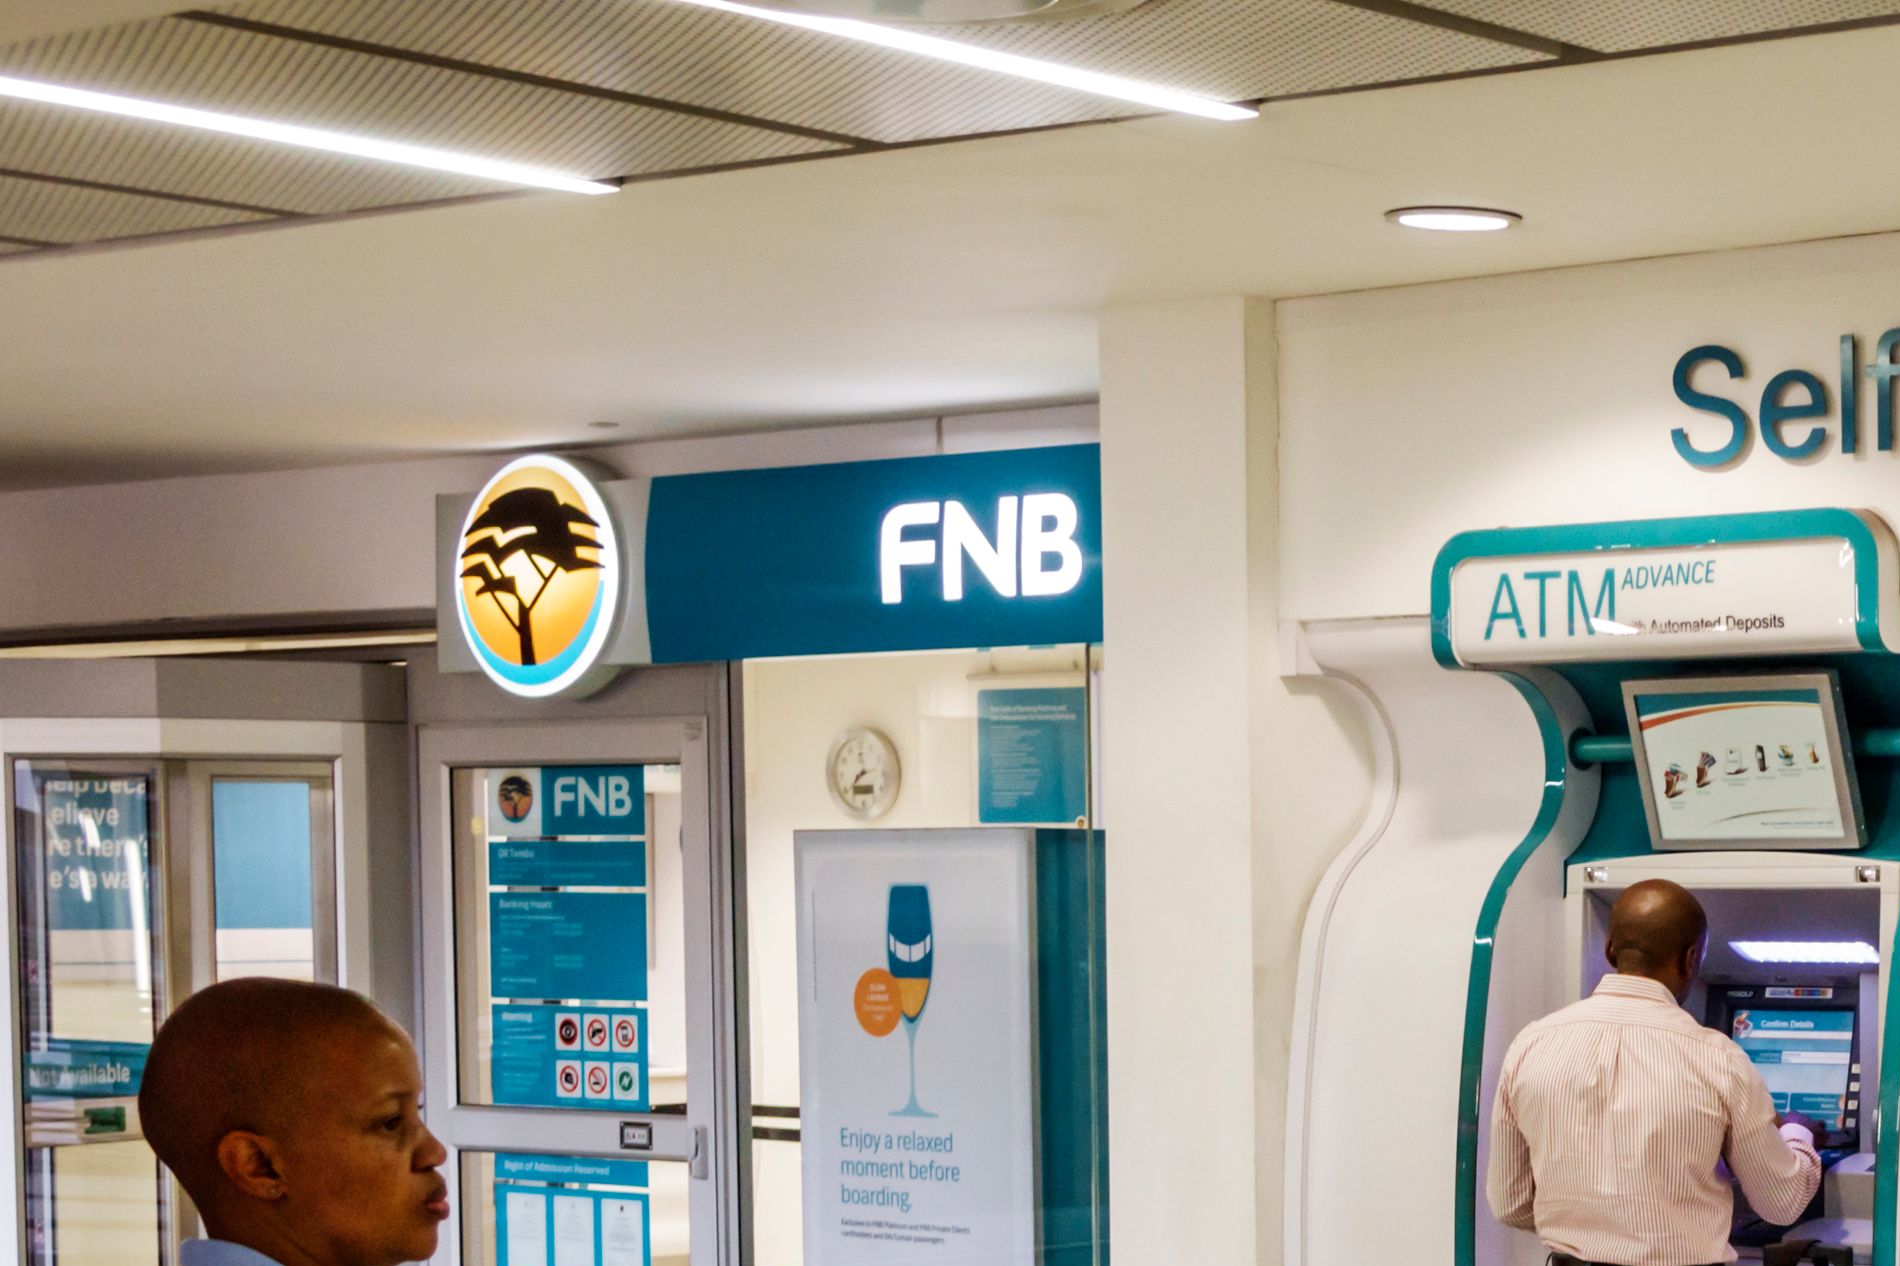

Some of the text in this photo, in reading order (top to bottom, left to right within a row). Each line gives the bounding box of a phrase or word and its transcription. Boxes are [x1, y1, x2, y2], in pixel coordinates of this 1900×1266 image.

[880, 492, 1084, 605] FNB
[1483, 560, 1716, 641] ATM ADVANCE
[1650, 615, 1722, 635] Automated
[1725, 613, 1785, 633] Deposits
[554, 775, 632, 817] FNB
[58, 1062, 130, 1087] Available
[840, 1127, 953, 1154] Enjoy a relaxed
[840, 1159, 960, 1182] moment before
[841, 1183, 912, 1213] boarding.
